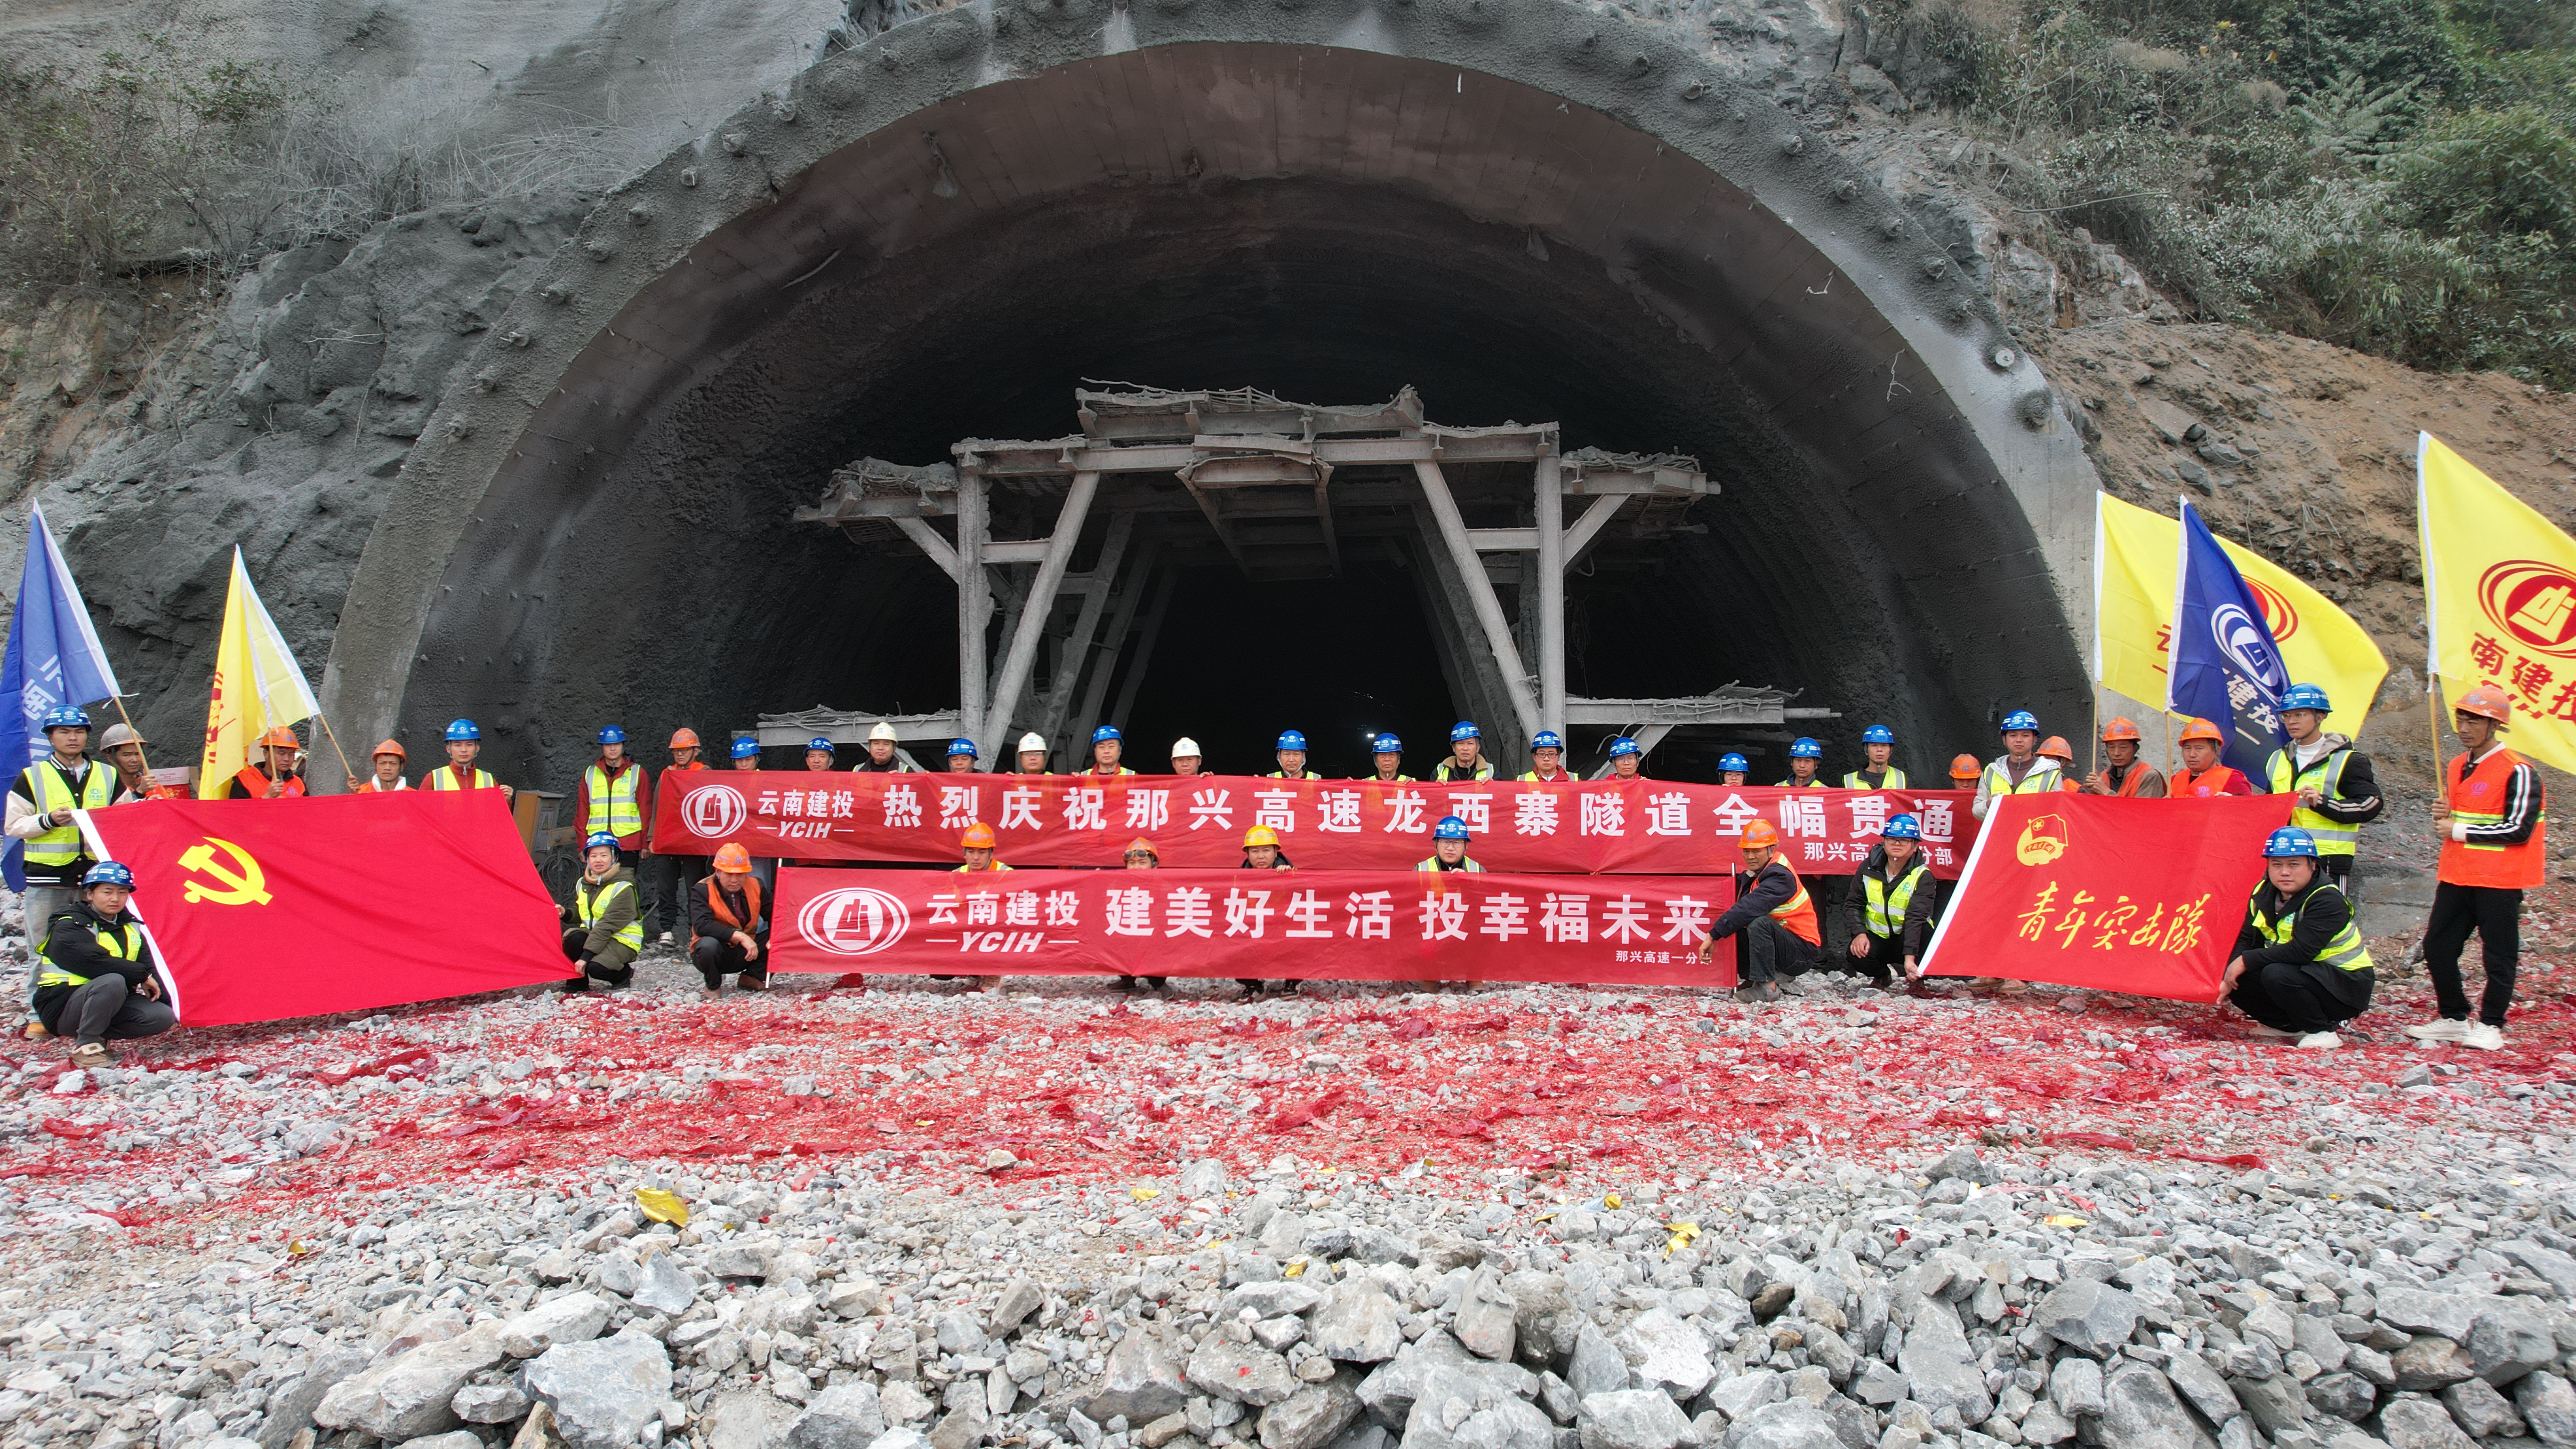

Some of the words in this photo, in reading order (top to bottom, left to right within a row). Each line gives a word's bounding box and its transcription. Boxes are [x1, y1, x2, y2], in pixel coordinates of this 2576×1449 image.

[2222, 668, 2279, 733] 建投
[758, 789, 854, 818] 云南建投
[883, 785, 1954, 843] 热烈庆祝那兴高速龙西寨隧道全幅贯通
[778, 821, 832, 838] YCIH
[1804, 842, 1953, 867] 那兴高分部
[926, 890, 1080, 926] 云南建投
[1104, 886, 1394, 940] 建美好生活
[1418, 891, 1711, 946] 投幸福未来
[960, 932, 1045, 953] YCIH
[1616, 950, 1712, 965] 那兴高速一分
